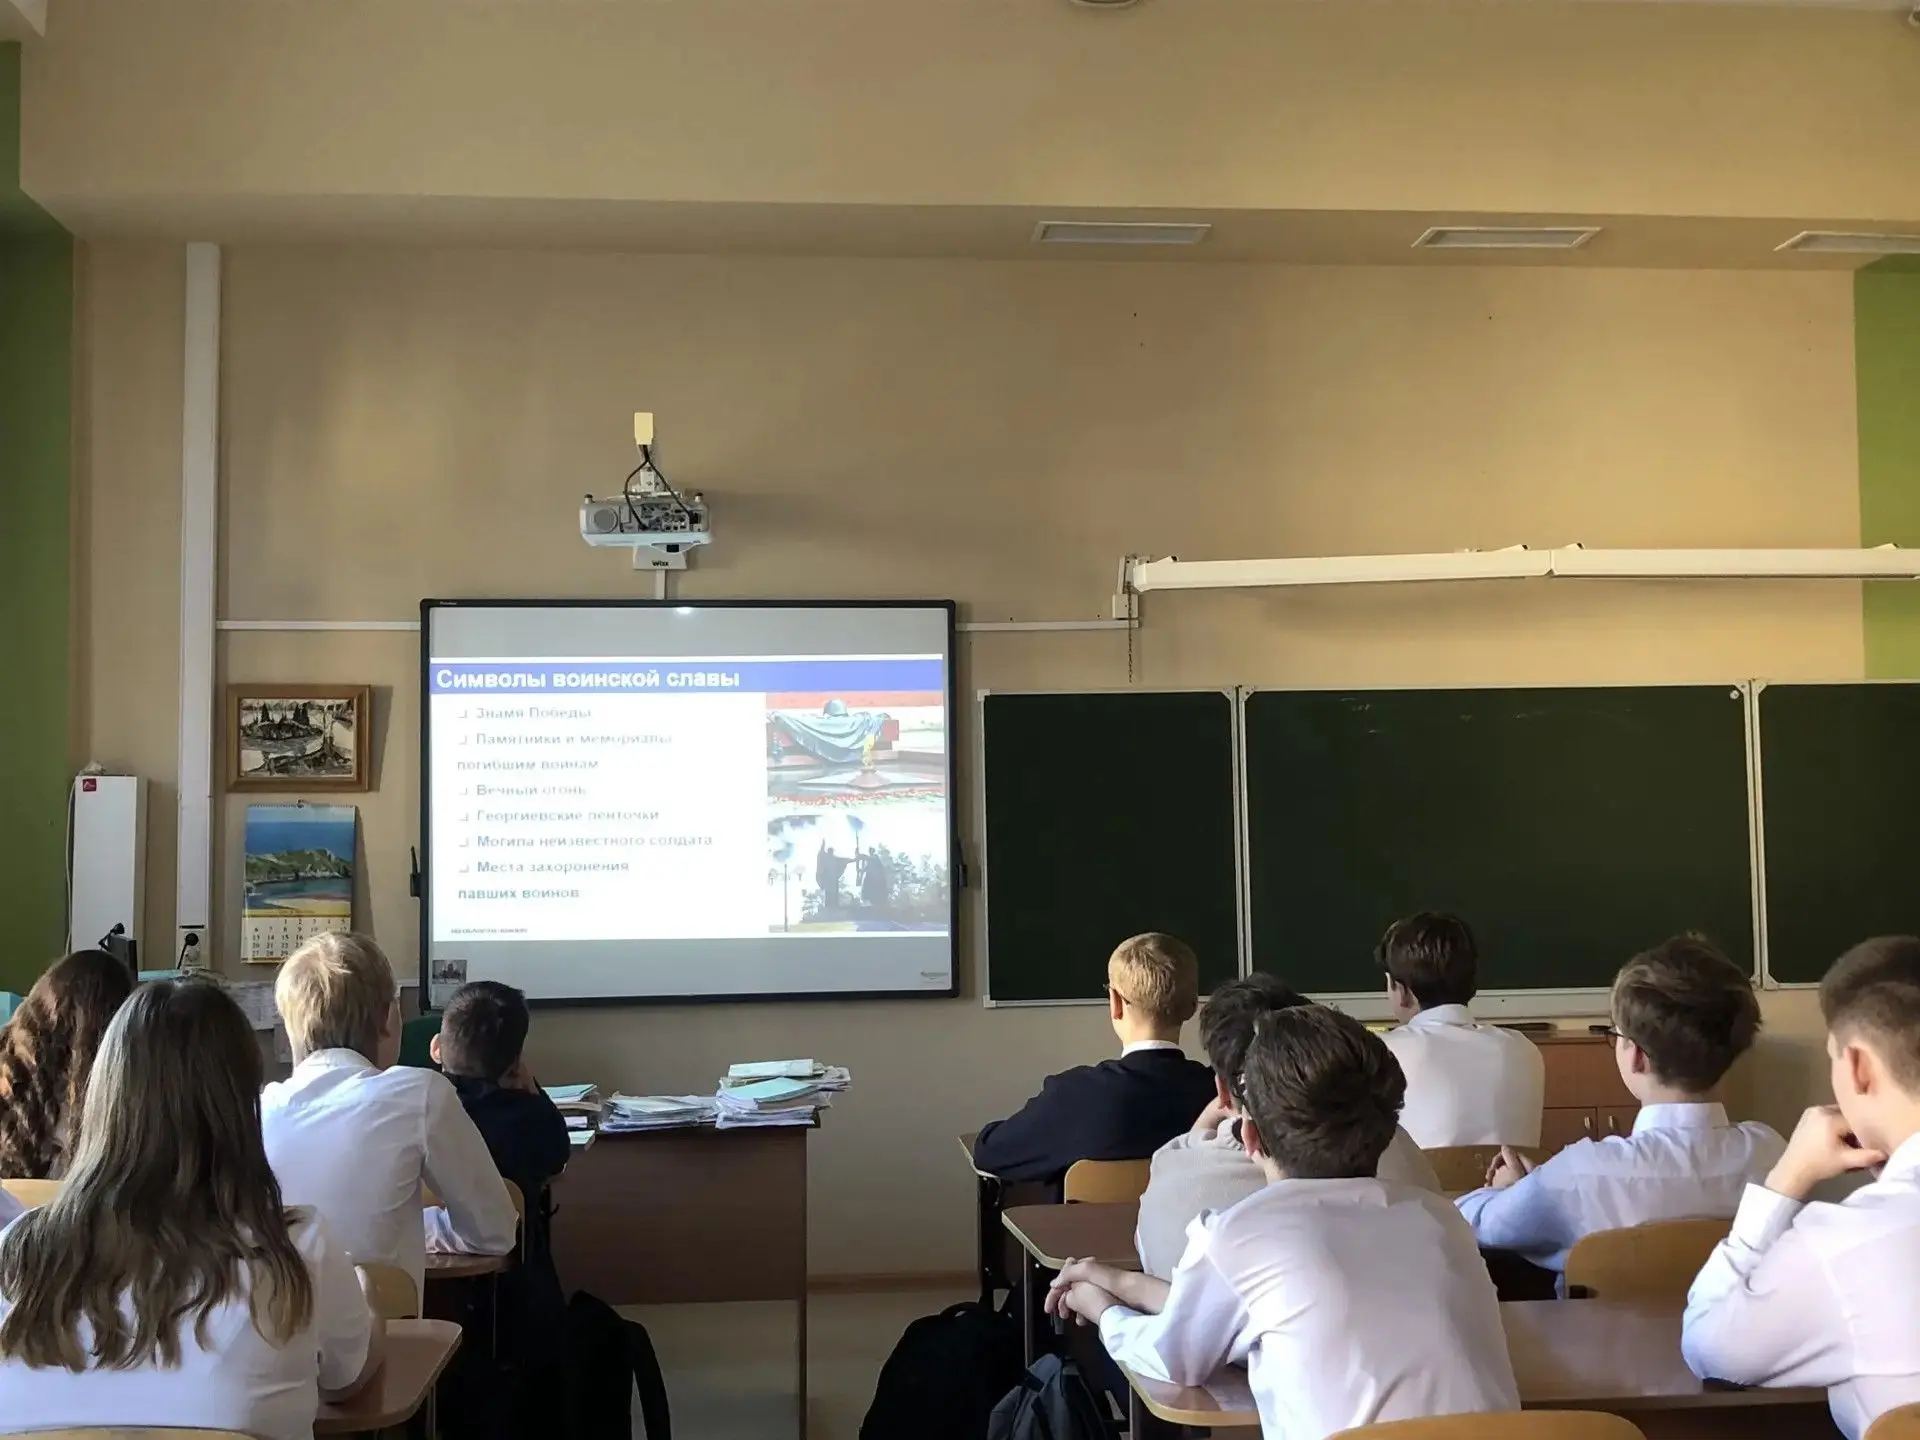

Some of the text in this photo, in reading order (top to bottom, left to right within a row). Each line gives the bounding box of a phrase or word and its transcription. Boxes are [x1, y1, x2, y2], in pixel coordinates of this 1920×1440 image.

[436, 668, 740, 689] Символы воинской славы
[475, 706, 592, 720] Знамя Победы
[475, 732, 672, 747] Памятники и мемориалы
[456, 759, 600, 771] погибшим воинам
[476, 783, 538, 796] Вечный
[476, 808, 583, 823] Георгиевские
[539, 835, 645, 848] неизвестного
[649, 835, 714, 848] солдата
[477, 860, 630, 875] Места захоронения
[457, 887, 580, 900] павших воинов
